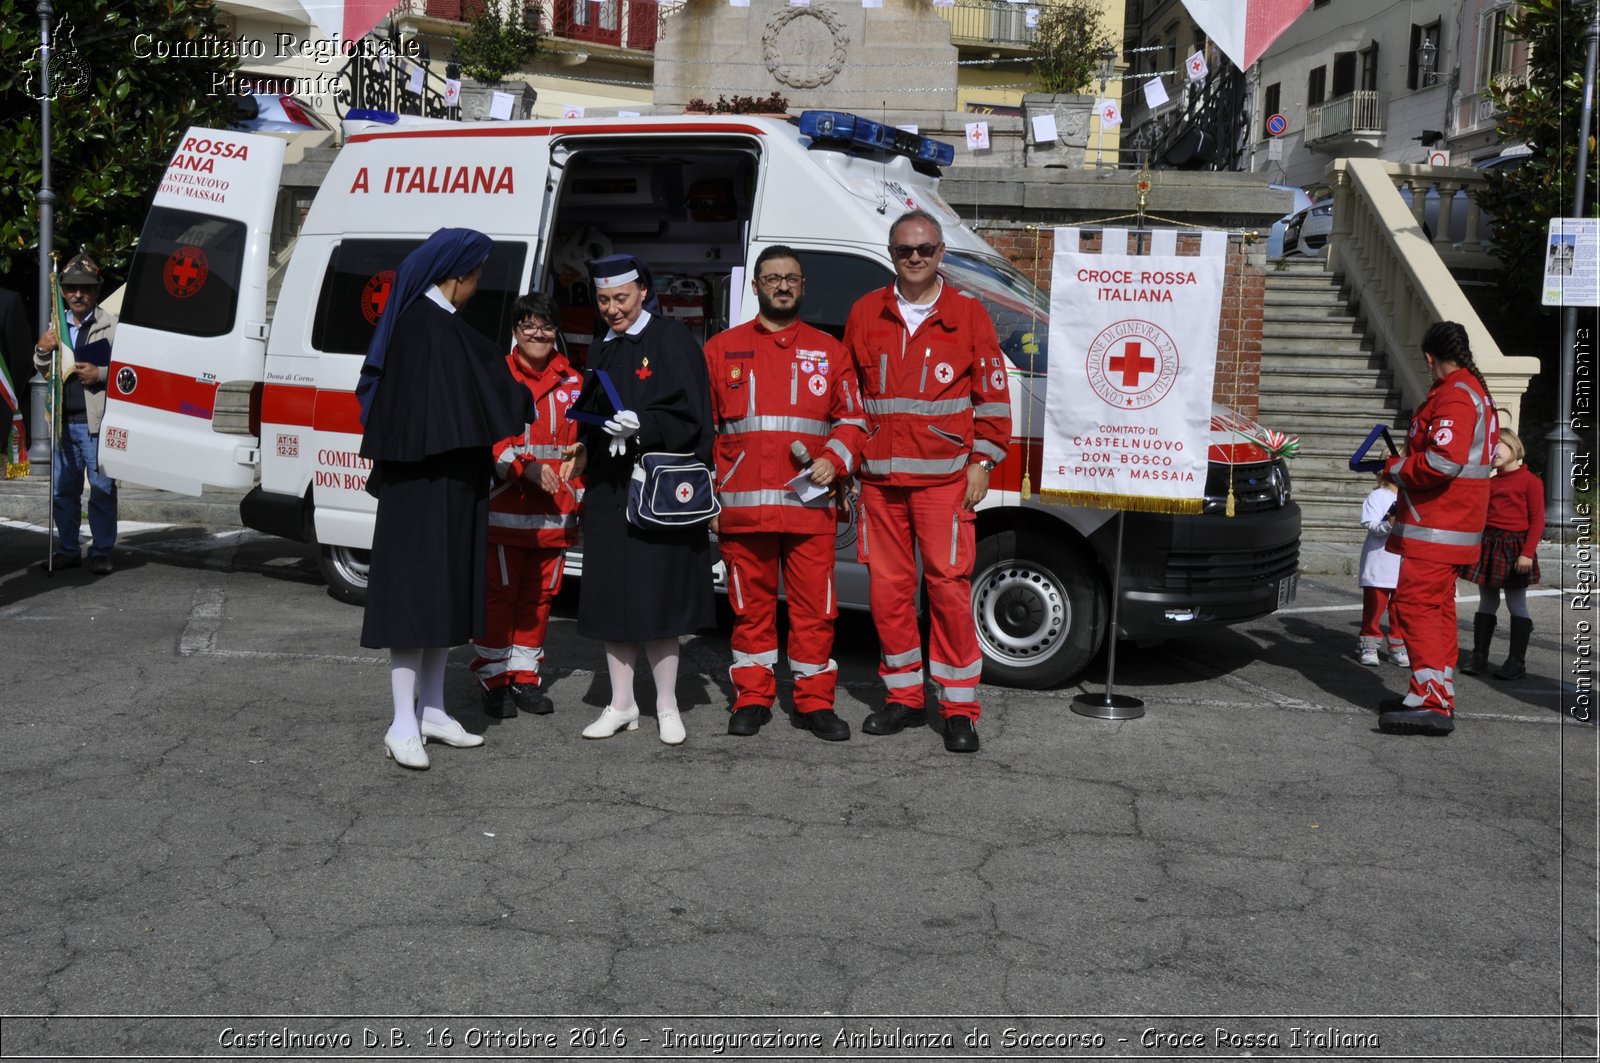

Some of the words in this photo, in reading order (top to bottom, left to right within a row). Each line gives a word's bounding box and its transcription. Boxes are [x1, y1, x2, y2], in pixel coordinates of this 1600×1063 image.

[183, 137, 248, 161] ROSSA
[165, 172, 229, 191] ASTELNUOVO
[350, 167, 369, 194] A
[384, 166, 514, 194] ITALIANA
[184, 187, 225, 204] MASSAIA
[1077, 269, 1133, 284] CROCE
[1141, 271, 1197, 285] ROSSA
[1098, 288, 1173, 303] ITALIANA
[1102, 331, 1116, 342] DI
[1115, 322, 1161, 342] GINEVRA
[1159, 341, 1172, 353] 22
[203, 372, 216, 380] TDI
[266, 372, 285, 380] Dono
[285, 373, 292, 381] di
[1089, 340, 1124, 405] CONVENZIONE
[1154, 355, 1175, 393] AGOSTO
[1136, 390, 1157, 405] 1864
[108, 428, 116, 437] AT
[118, 430, 127, 439] 14
[1100, 425, 1145, 435] COMITATO
[1149, 427, 1158, 435] DI
[106, 438, 126, 450] 12-25
[278, 436, 287, 444] AT
[289, 437, 298, 445] 14
[1073, 436, 1184, 451] CASTELNUOVO
[278, 446, 298, 456] 12-25
[1082, 452, 1111, 463] DON
[1120, 454, 1172, 466] BOSCO
[315, 471, 341, 489] DON
[1058, 465, 1066, 475] E
[1074, 466, 1121, 478] PIOVA'
[1130, 469, 1194, 482] MASSAIA
